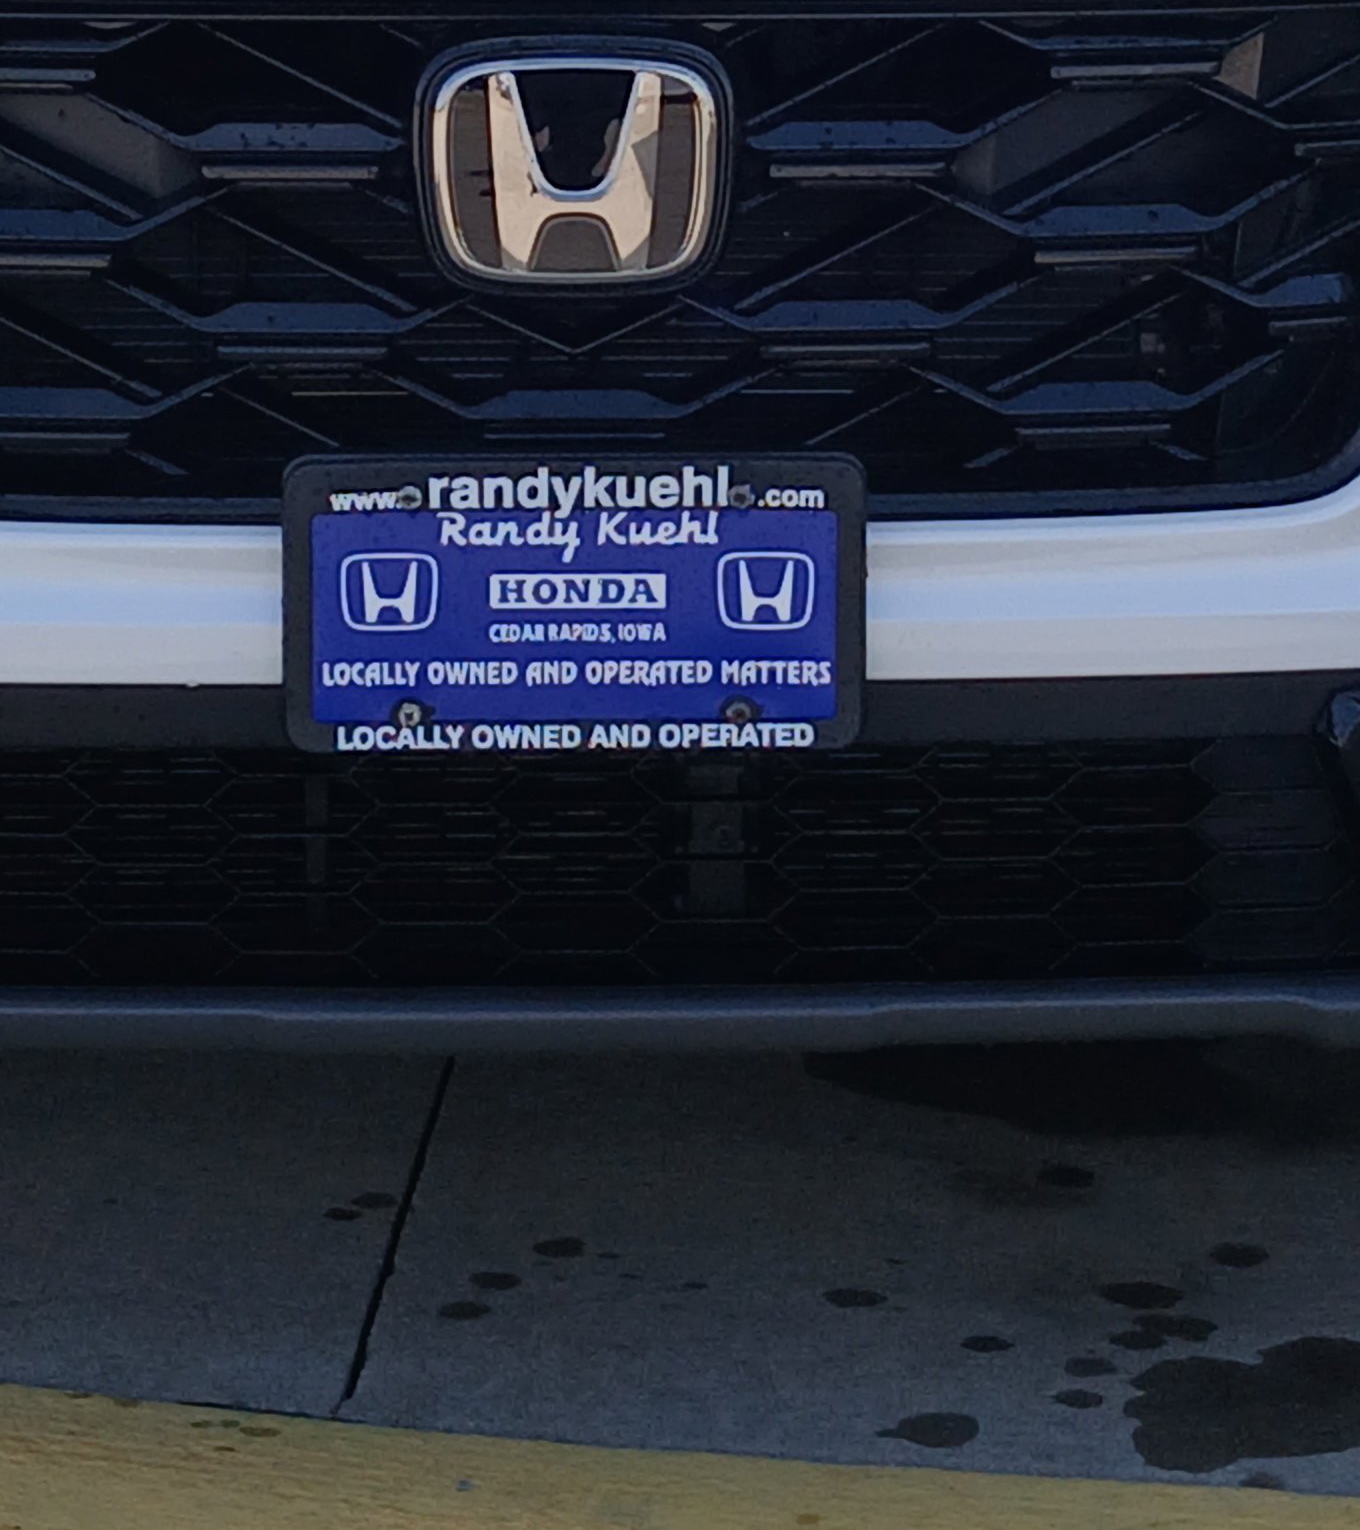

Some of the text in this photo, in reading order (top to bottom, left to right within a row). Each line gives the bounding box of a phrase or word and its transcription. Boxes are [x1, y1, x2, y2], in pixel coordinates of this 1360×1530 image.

[428, 466, 730, 520] randykuehl
[757, 489, 825, 509] .com
[436, 511, 719, 564] Randy Kuehl
[498, 578, 658, 605] HONDA
[618, 622, 667, 642] IOWA
[322, 659, 832, 687] LOCALLY OWNED AND OPERATED MATTERS
[337, 722, 815, 751] LOCALLY OWNED AND OPERATED
